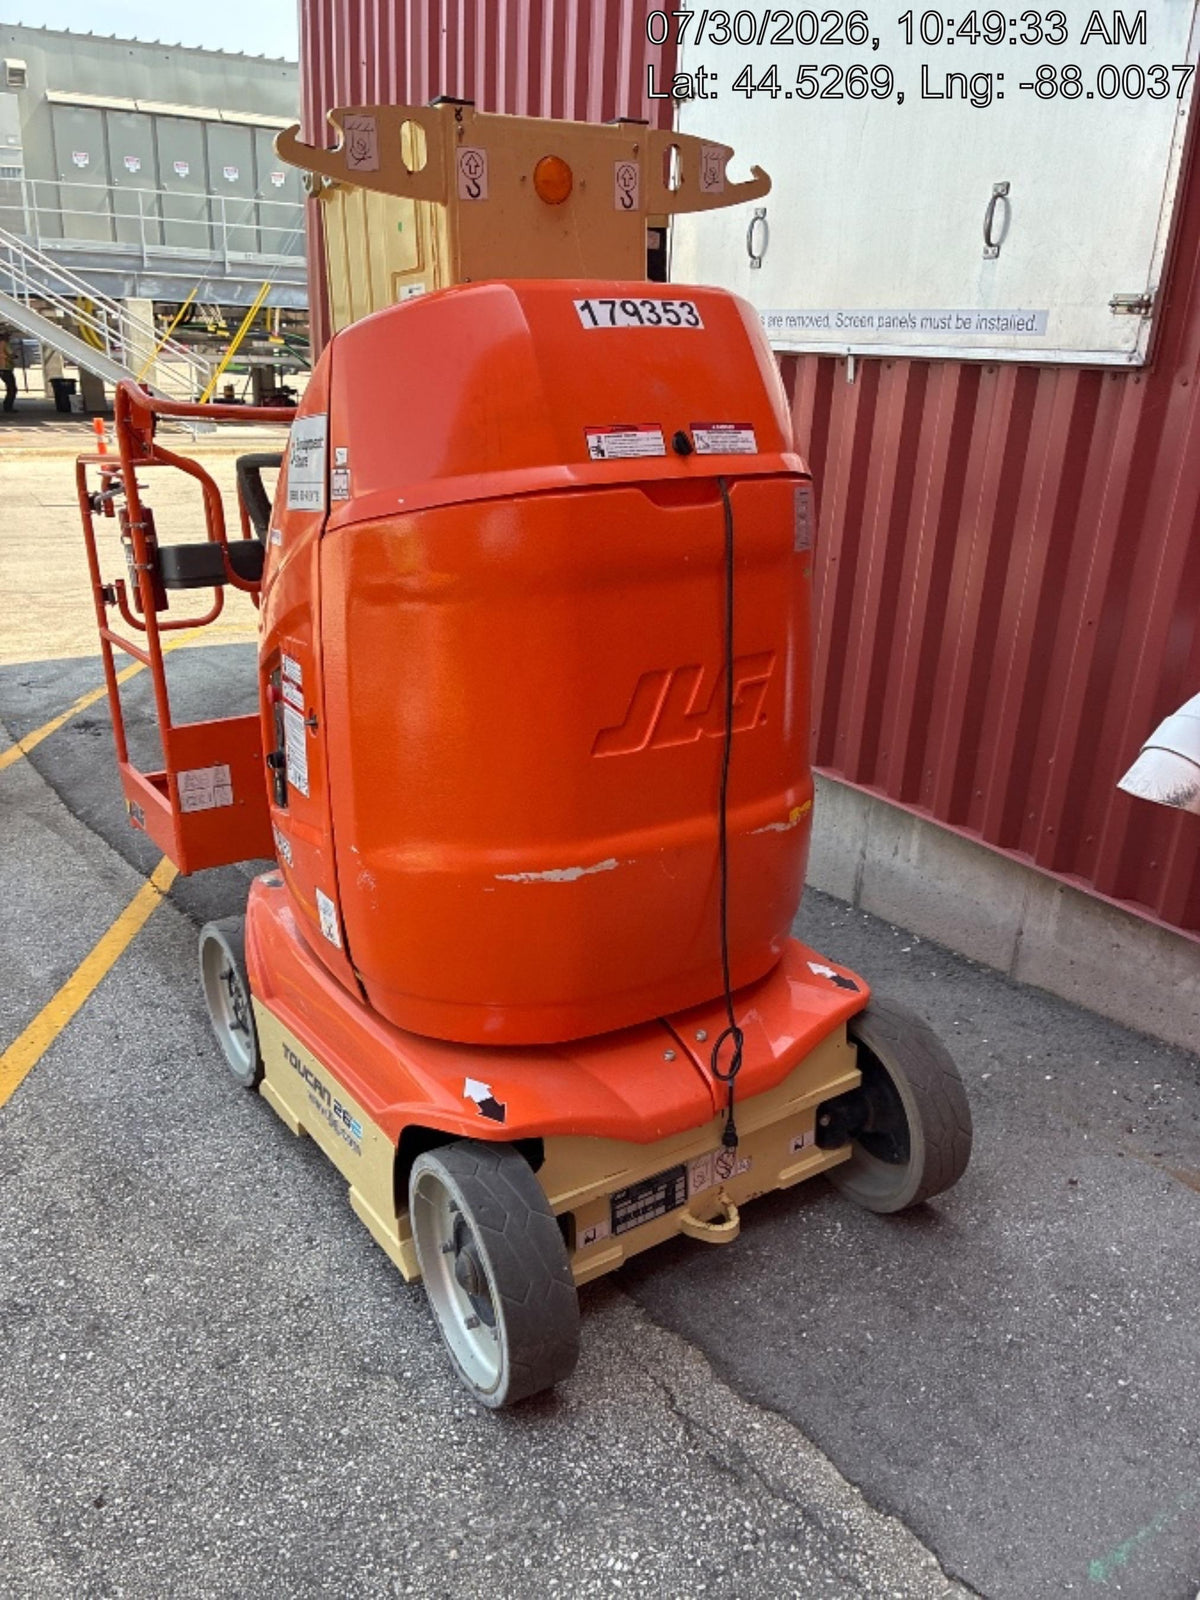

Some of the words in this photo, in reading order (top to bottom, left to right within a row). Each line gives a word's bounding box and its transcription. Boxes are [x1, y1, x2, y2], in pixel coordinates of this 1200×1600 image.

[580, 300, 700, 326] 179353
[767, 315, 783, 328] are
[835, 312, 875, 328] Screen
[876, 313, 917, 331] panels
[920, 314, 952, 330] must
[955, 314, 972, 330] be
[975, 313, 1038, 332] installed.
[590, 650, 776, 758] JLG
[282, 1041, 331, 1108] TOUCAN
